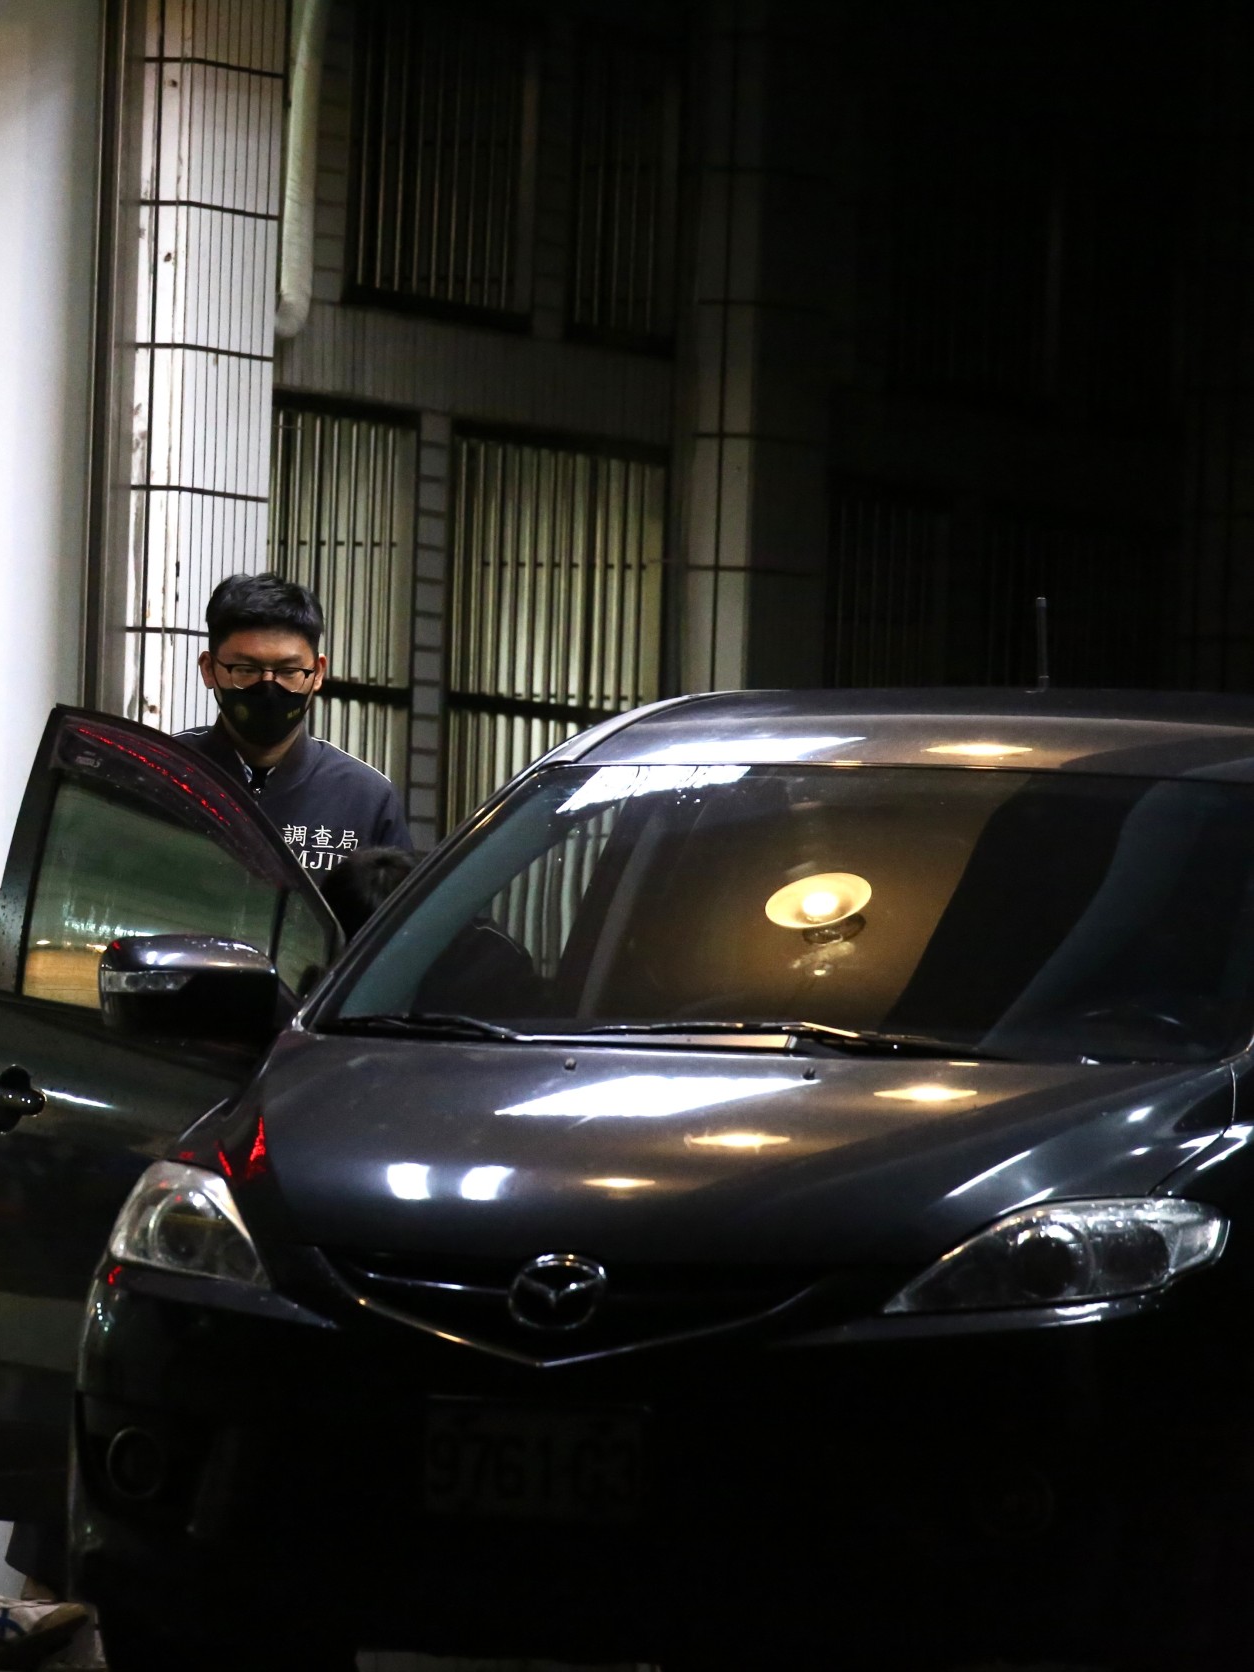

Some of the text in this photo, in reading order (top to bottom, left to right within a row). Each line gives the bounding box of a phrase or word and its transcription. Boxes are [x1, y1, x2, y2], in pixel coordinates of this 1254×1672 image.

[282, 824, 359, 851] 調查局
[291, 849, 349, 871] MJI
